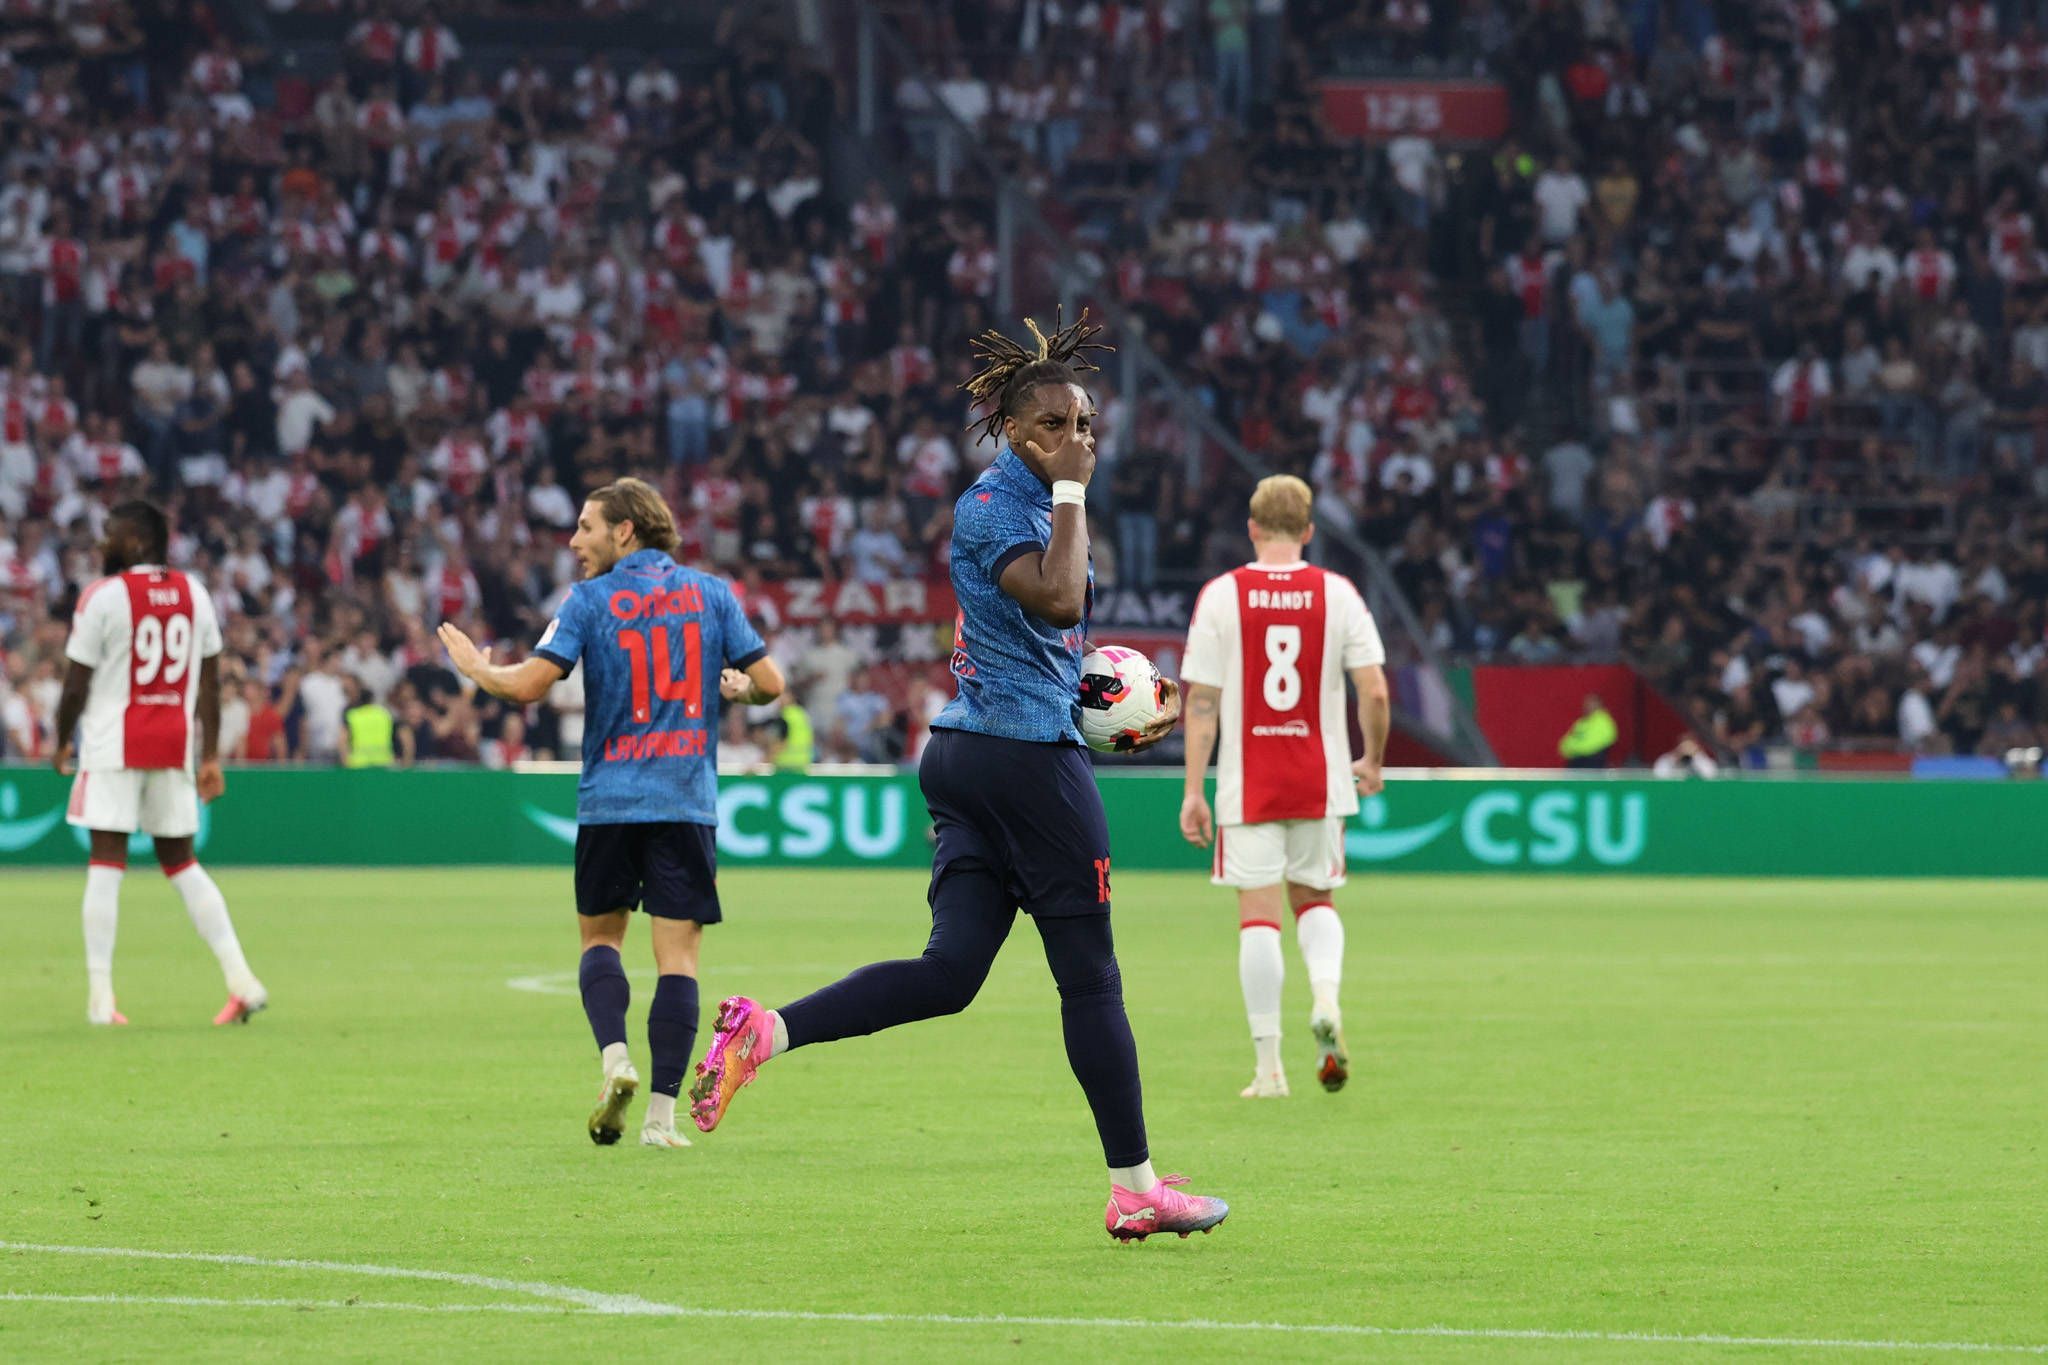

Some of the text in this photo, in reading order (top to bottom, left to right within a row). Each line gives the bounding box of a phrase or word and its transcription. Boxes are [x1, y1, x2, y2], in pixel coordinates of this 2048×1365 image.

[1248, 589, 1314, 609] BRANDT
[135, 613, 191, 685] 99
[617, 622, 703, 724] 14
[1263, 624, 1302, 712] 8
[717, 784, 906, 858] CSU
[1462, 790, 1648, 865] CSU
